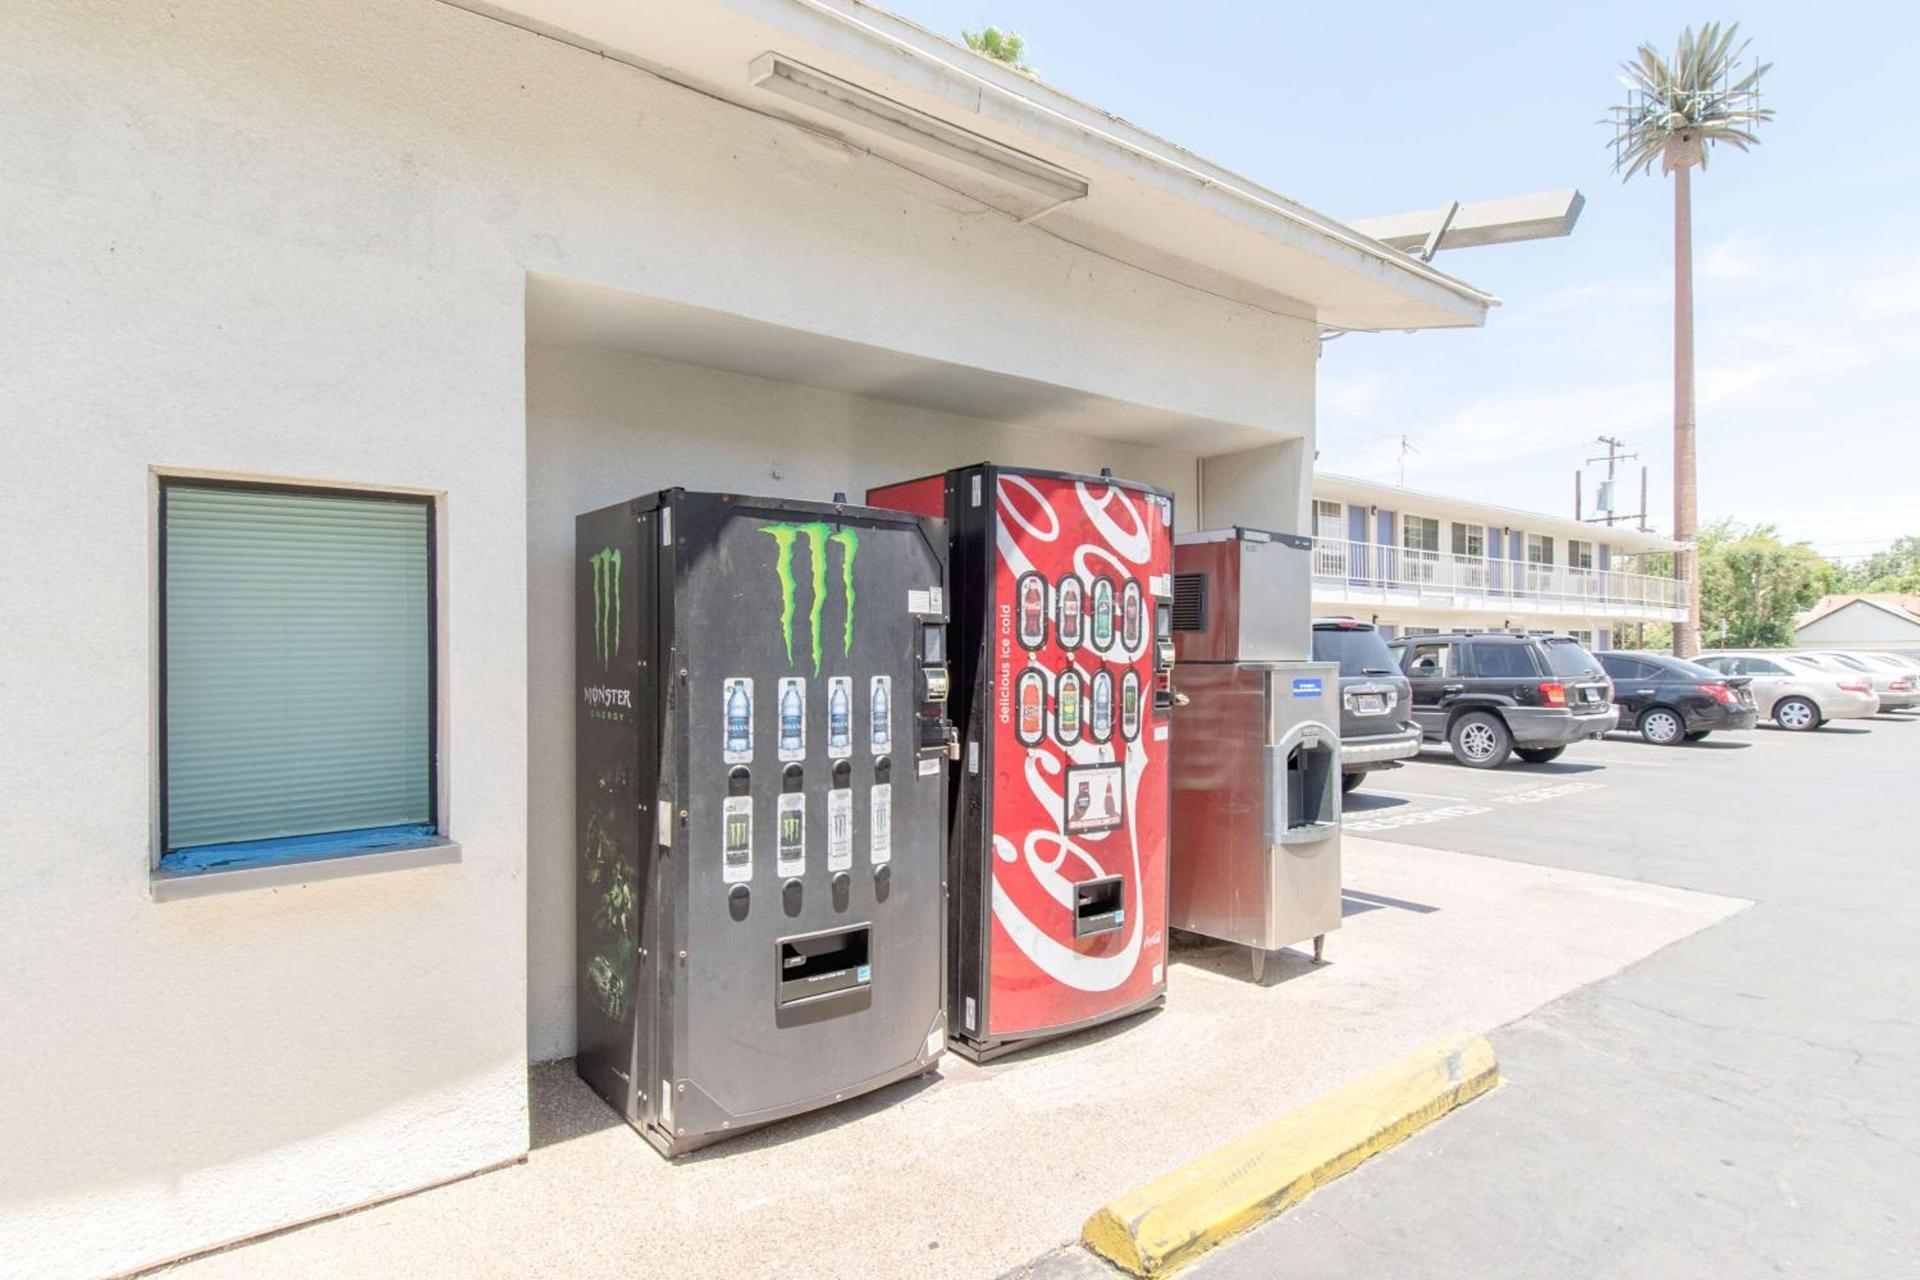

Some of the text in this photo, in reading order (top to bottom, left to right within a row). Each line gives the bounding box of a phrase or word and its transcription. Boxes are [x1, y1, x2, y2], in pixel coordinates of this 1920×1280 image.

[583, 684, 632, 709] MONSTER
[999, 604, 1011, 724] delicious ice cold
